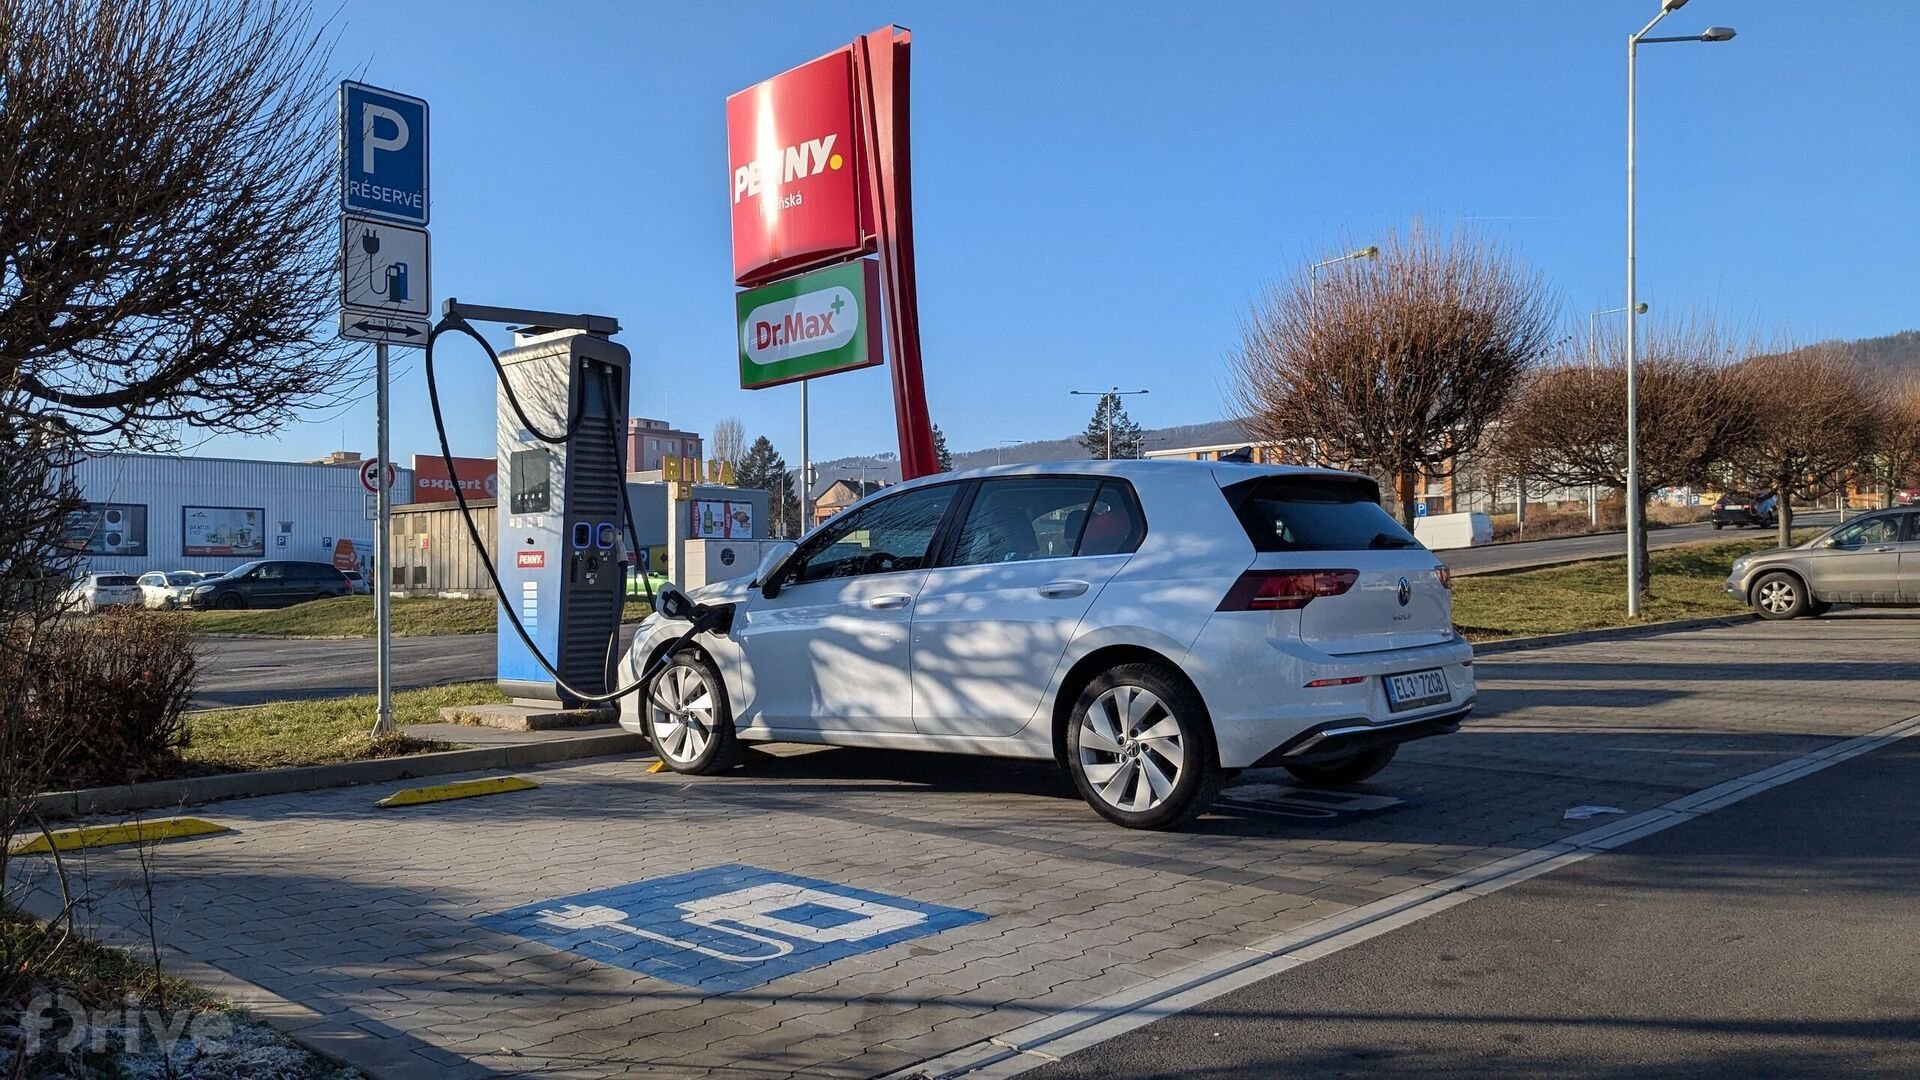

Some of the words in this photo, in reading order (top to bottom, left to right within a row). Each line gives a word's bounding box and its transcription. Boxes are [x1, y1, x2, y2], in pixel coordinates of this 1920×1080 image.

[363, 102, 409, 175] P
[350, 180, 423, 209] RÉSERVÉ
[662, 455, 735, 484] BILLA
[419, 478, 481, 490] expert
[1418, 504, 1425, 514] P
[278, 536, 284, 545] P
[324, 538, 331, 546] P
[1394, 677, 1415, 700] EL3
[1419, 671, 1444, 696] 72CB
